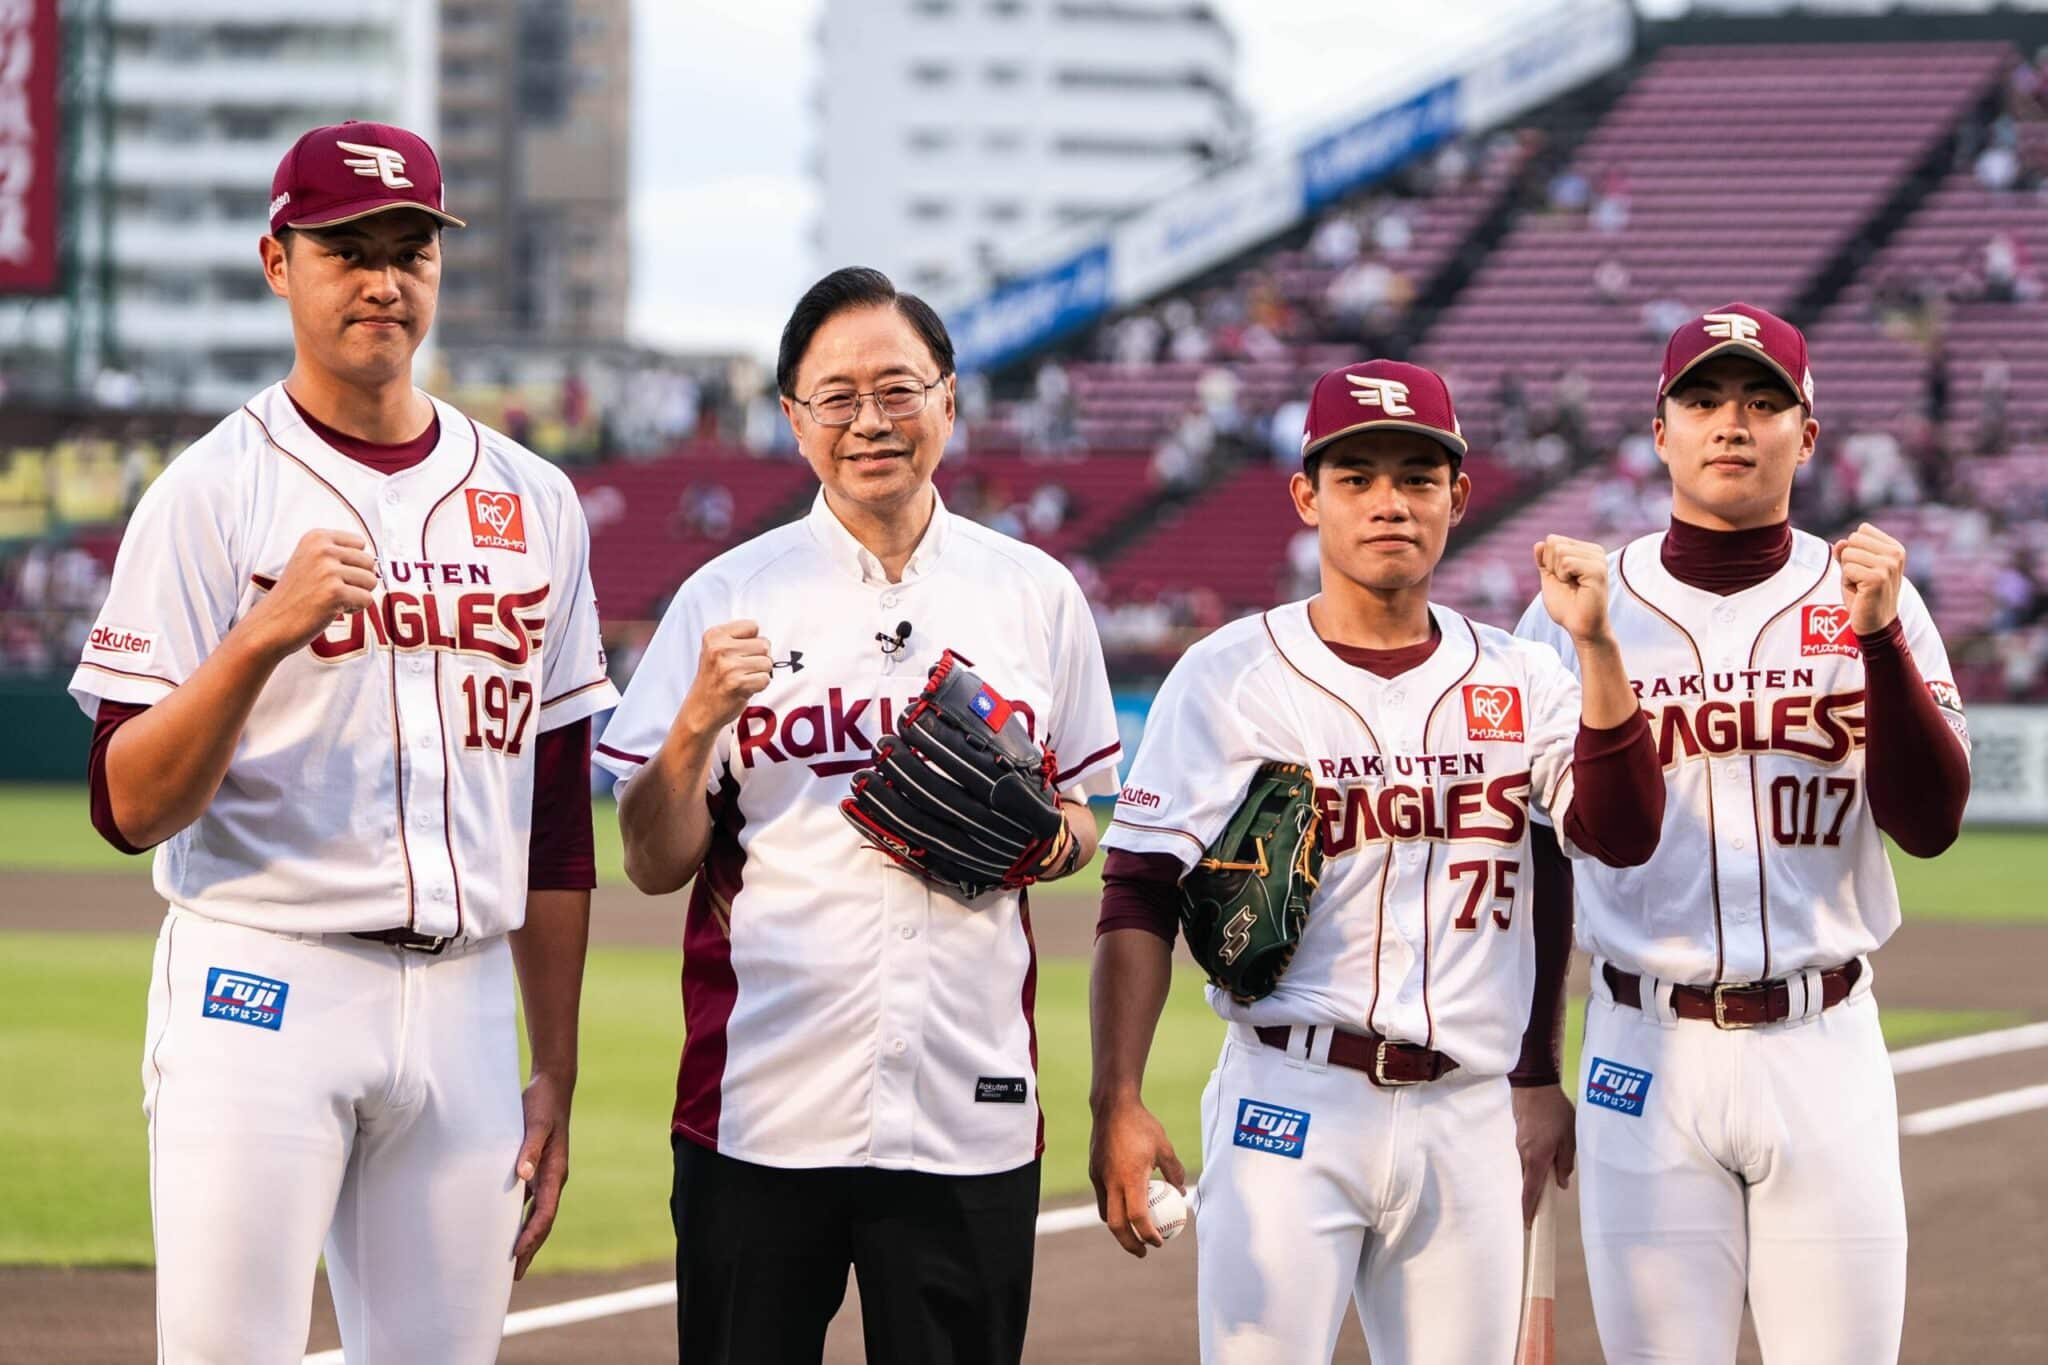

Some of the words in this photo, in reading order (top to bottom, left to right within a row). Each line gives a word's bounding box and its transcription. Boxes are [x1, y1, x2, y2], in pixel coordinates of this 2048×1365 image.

[376, 560, 492, 585] UTEN
[90, 626, 151, 654] akuten
[461, 674, 533, 757] 197
[1642, 690, 1865, 768] AGLES
[1318, 752, 1485, 778] RAKUTEN
[1119, 784, 1161, 809] kuten
[1314, 770, 1530, 861] EAGLES
[1771, 775, 1858, 847] 017
[1449, 859, 1520, 931] 75
[208, 1003, 275, 1024] タイヤはフジ
[1014, 1083, 1024, 1093] XL
